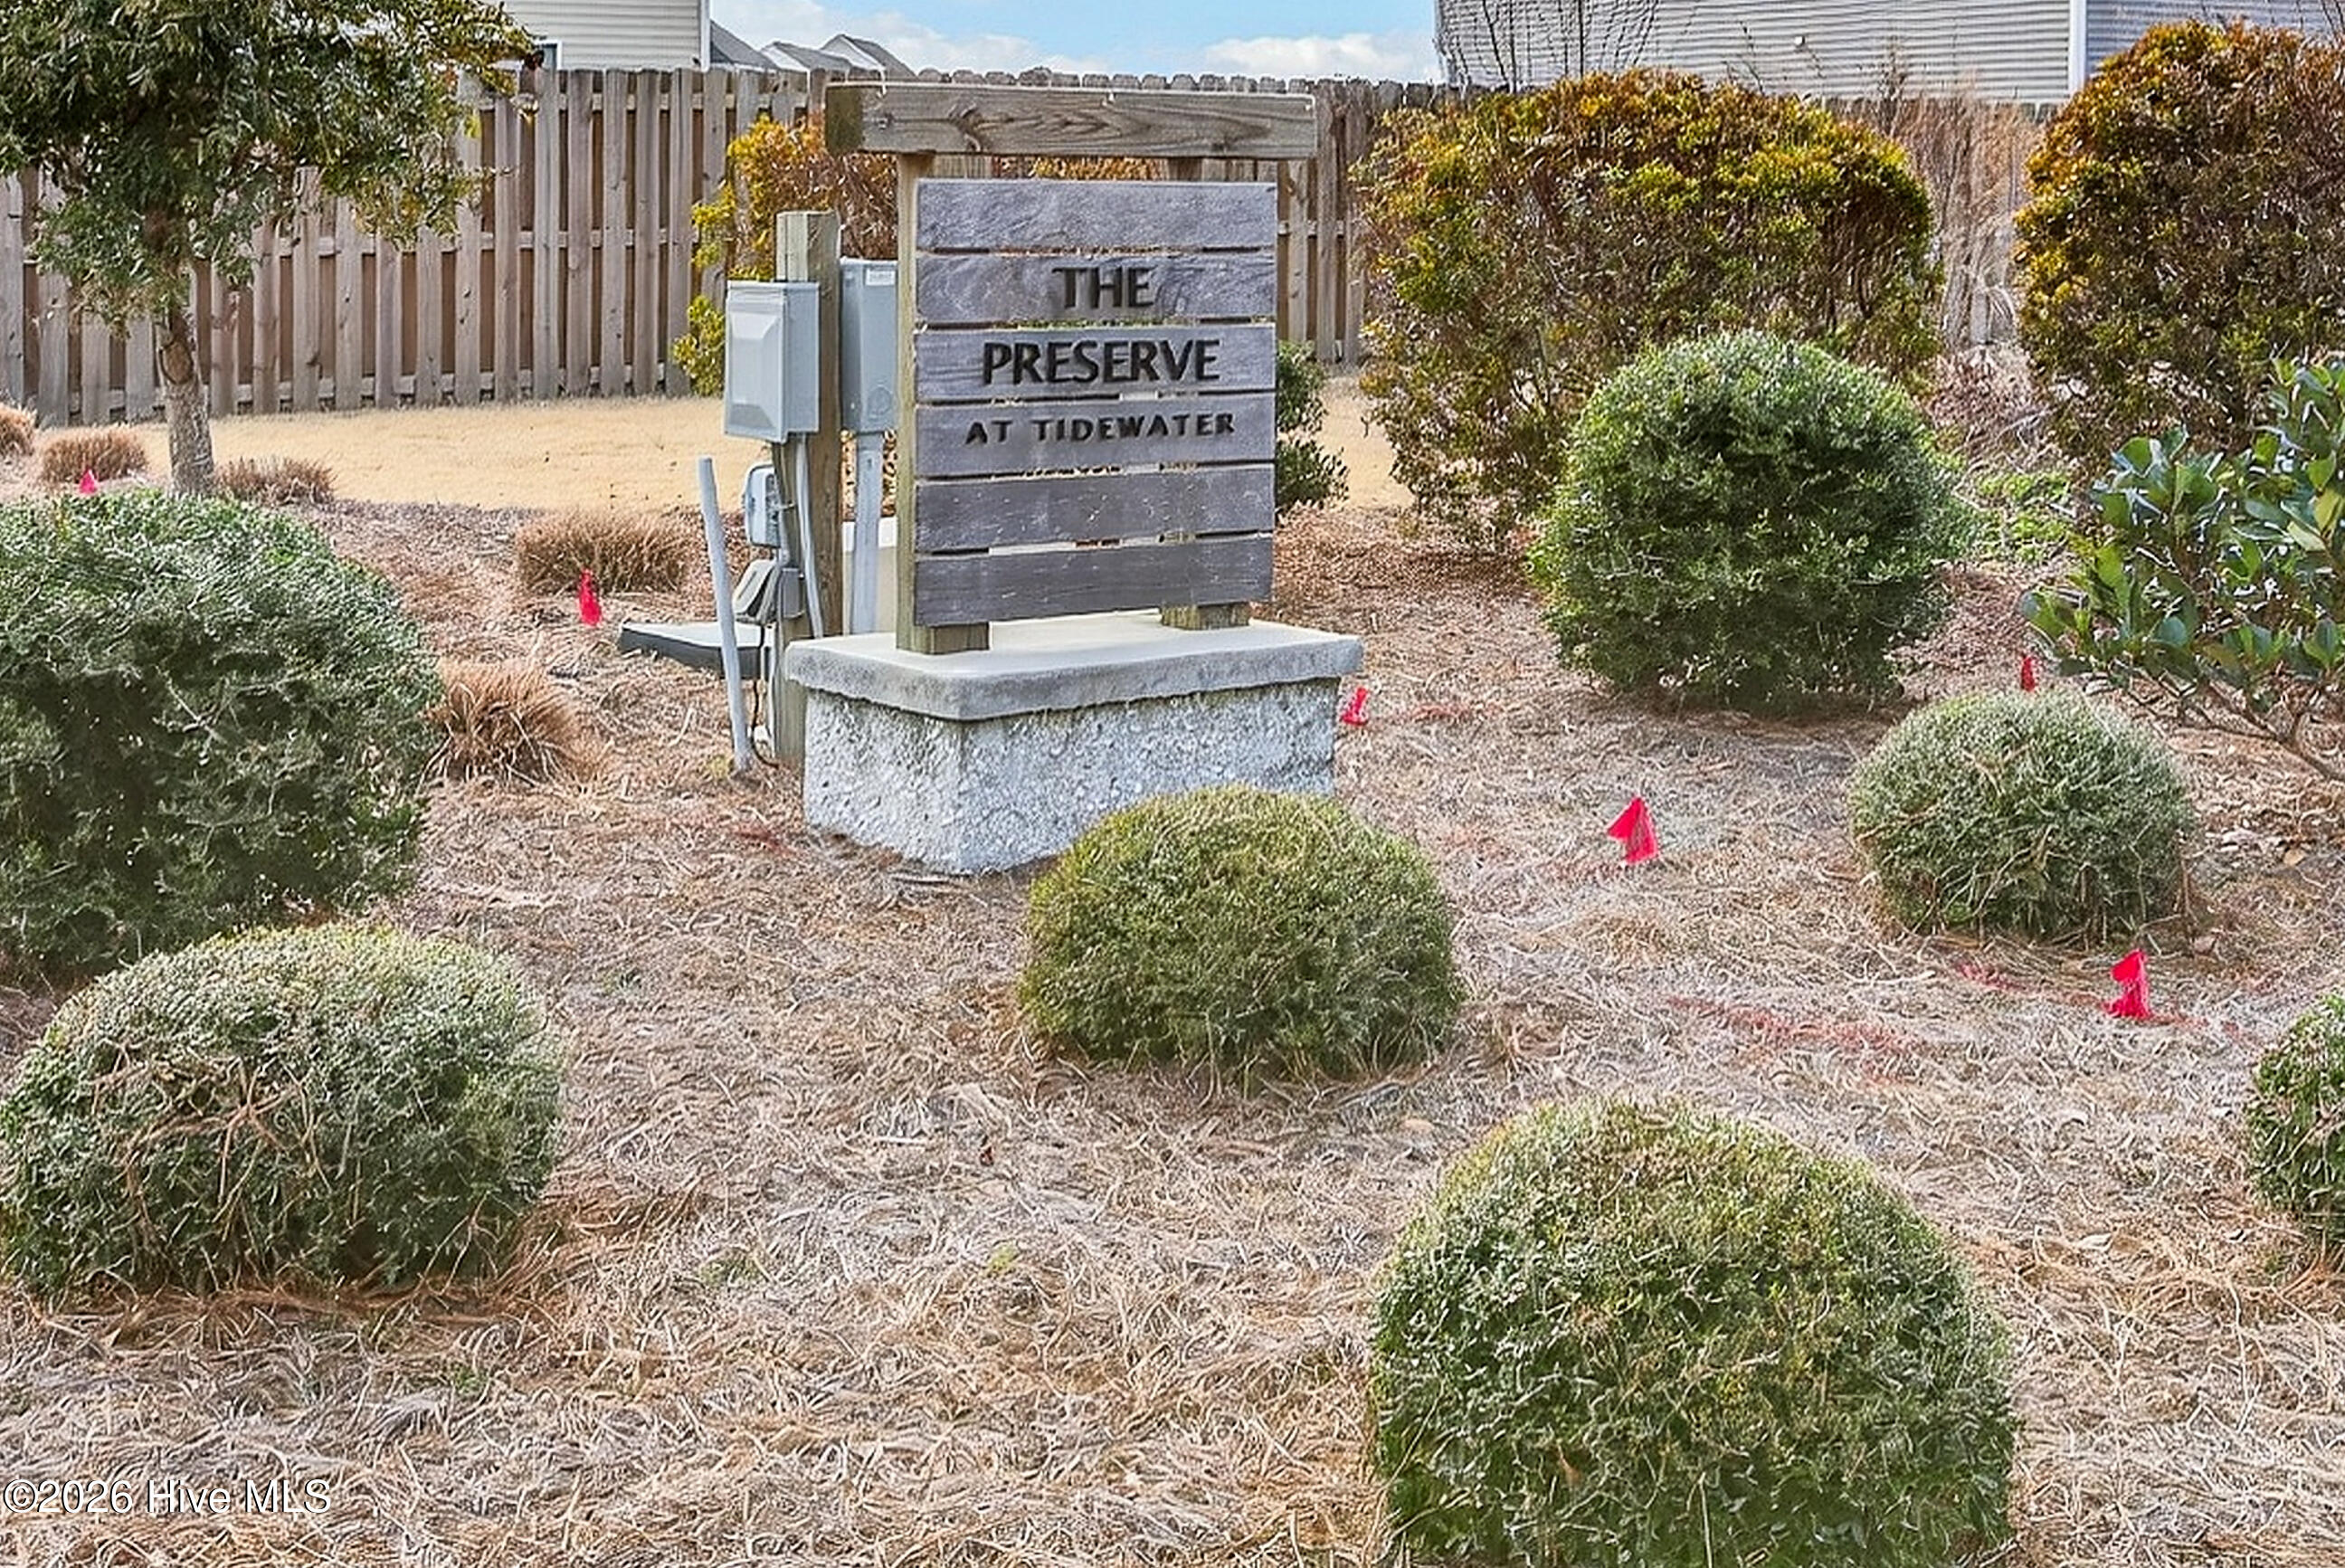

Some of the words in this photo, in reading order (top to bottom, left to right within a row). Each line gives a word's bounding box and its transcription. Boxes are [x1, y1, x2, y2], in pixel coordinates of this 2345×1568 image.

[1052, 266, 1156, 309] THE
[982, 338, 1220, 386] PRESERVE
[965, 420, 1012, 446] AT
[1033, 412, 1236, 442] TIDEWATER
